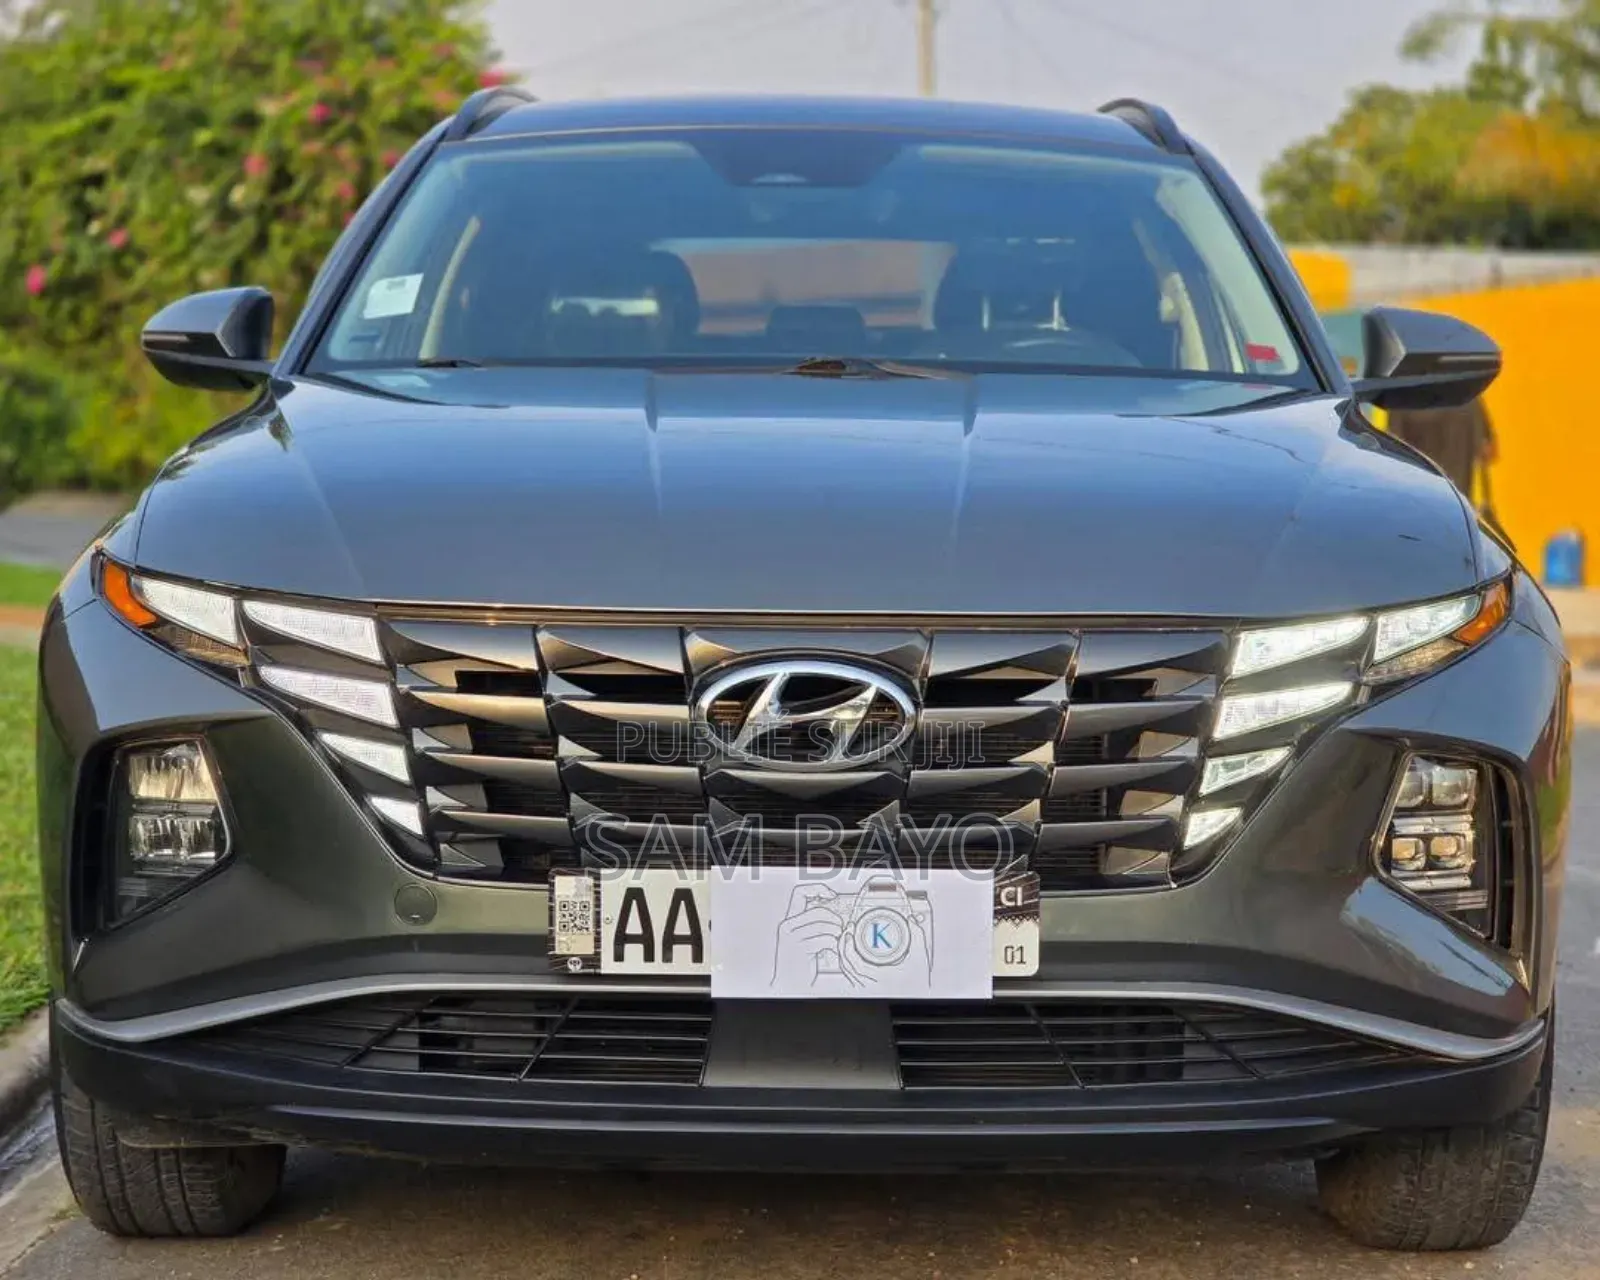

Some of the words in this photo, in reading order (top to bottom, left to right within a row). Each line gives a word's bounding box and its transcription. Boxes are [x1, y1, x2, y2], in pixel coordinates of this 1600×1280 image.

[1001, 886, 1023, 906] CI
[613, 887, 711, 963] AA
[870, 921, 893, 948] K
[1004, 945, 1027, 964] 01
